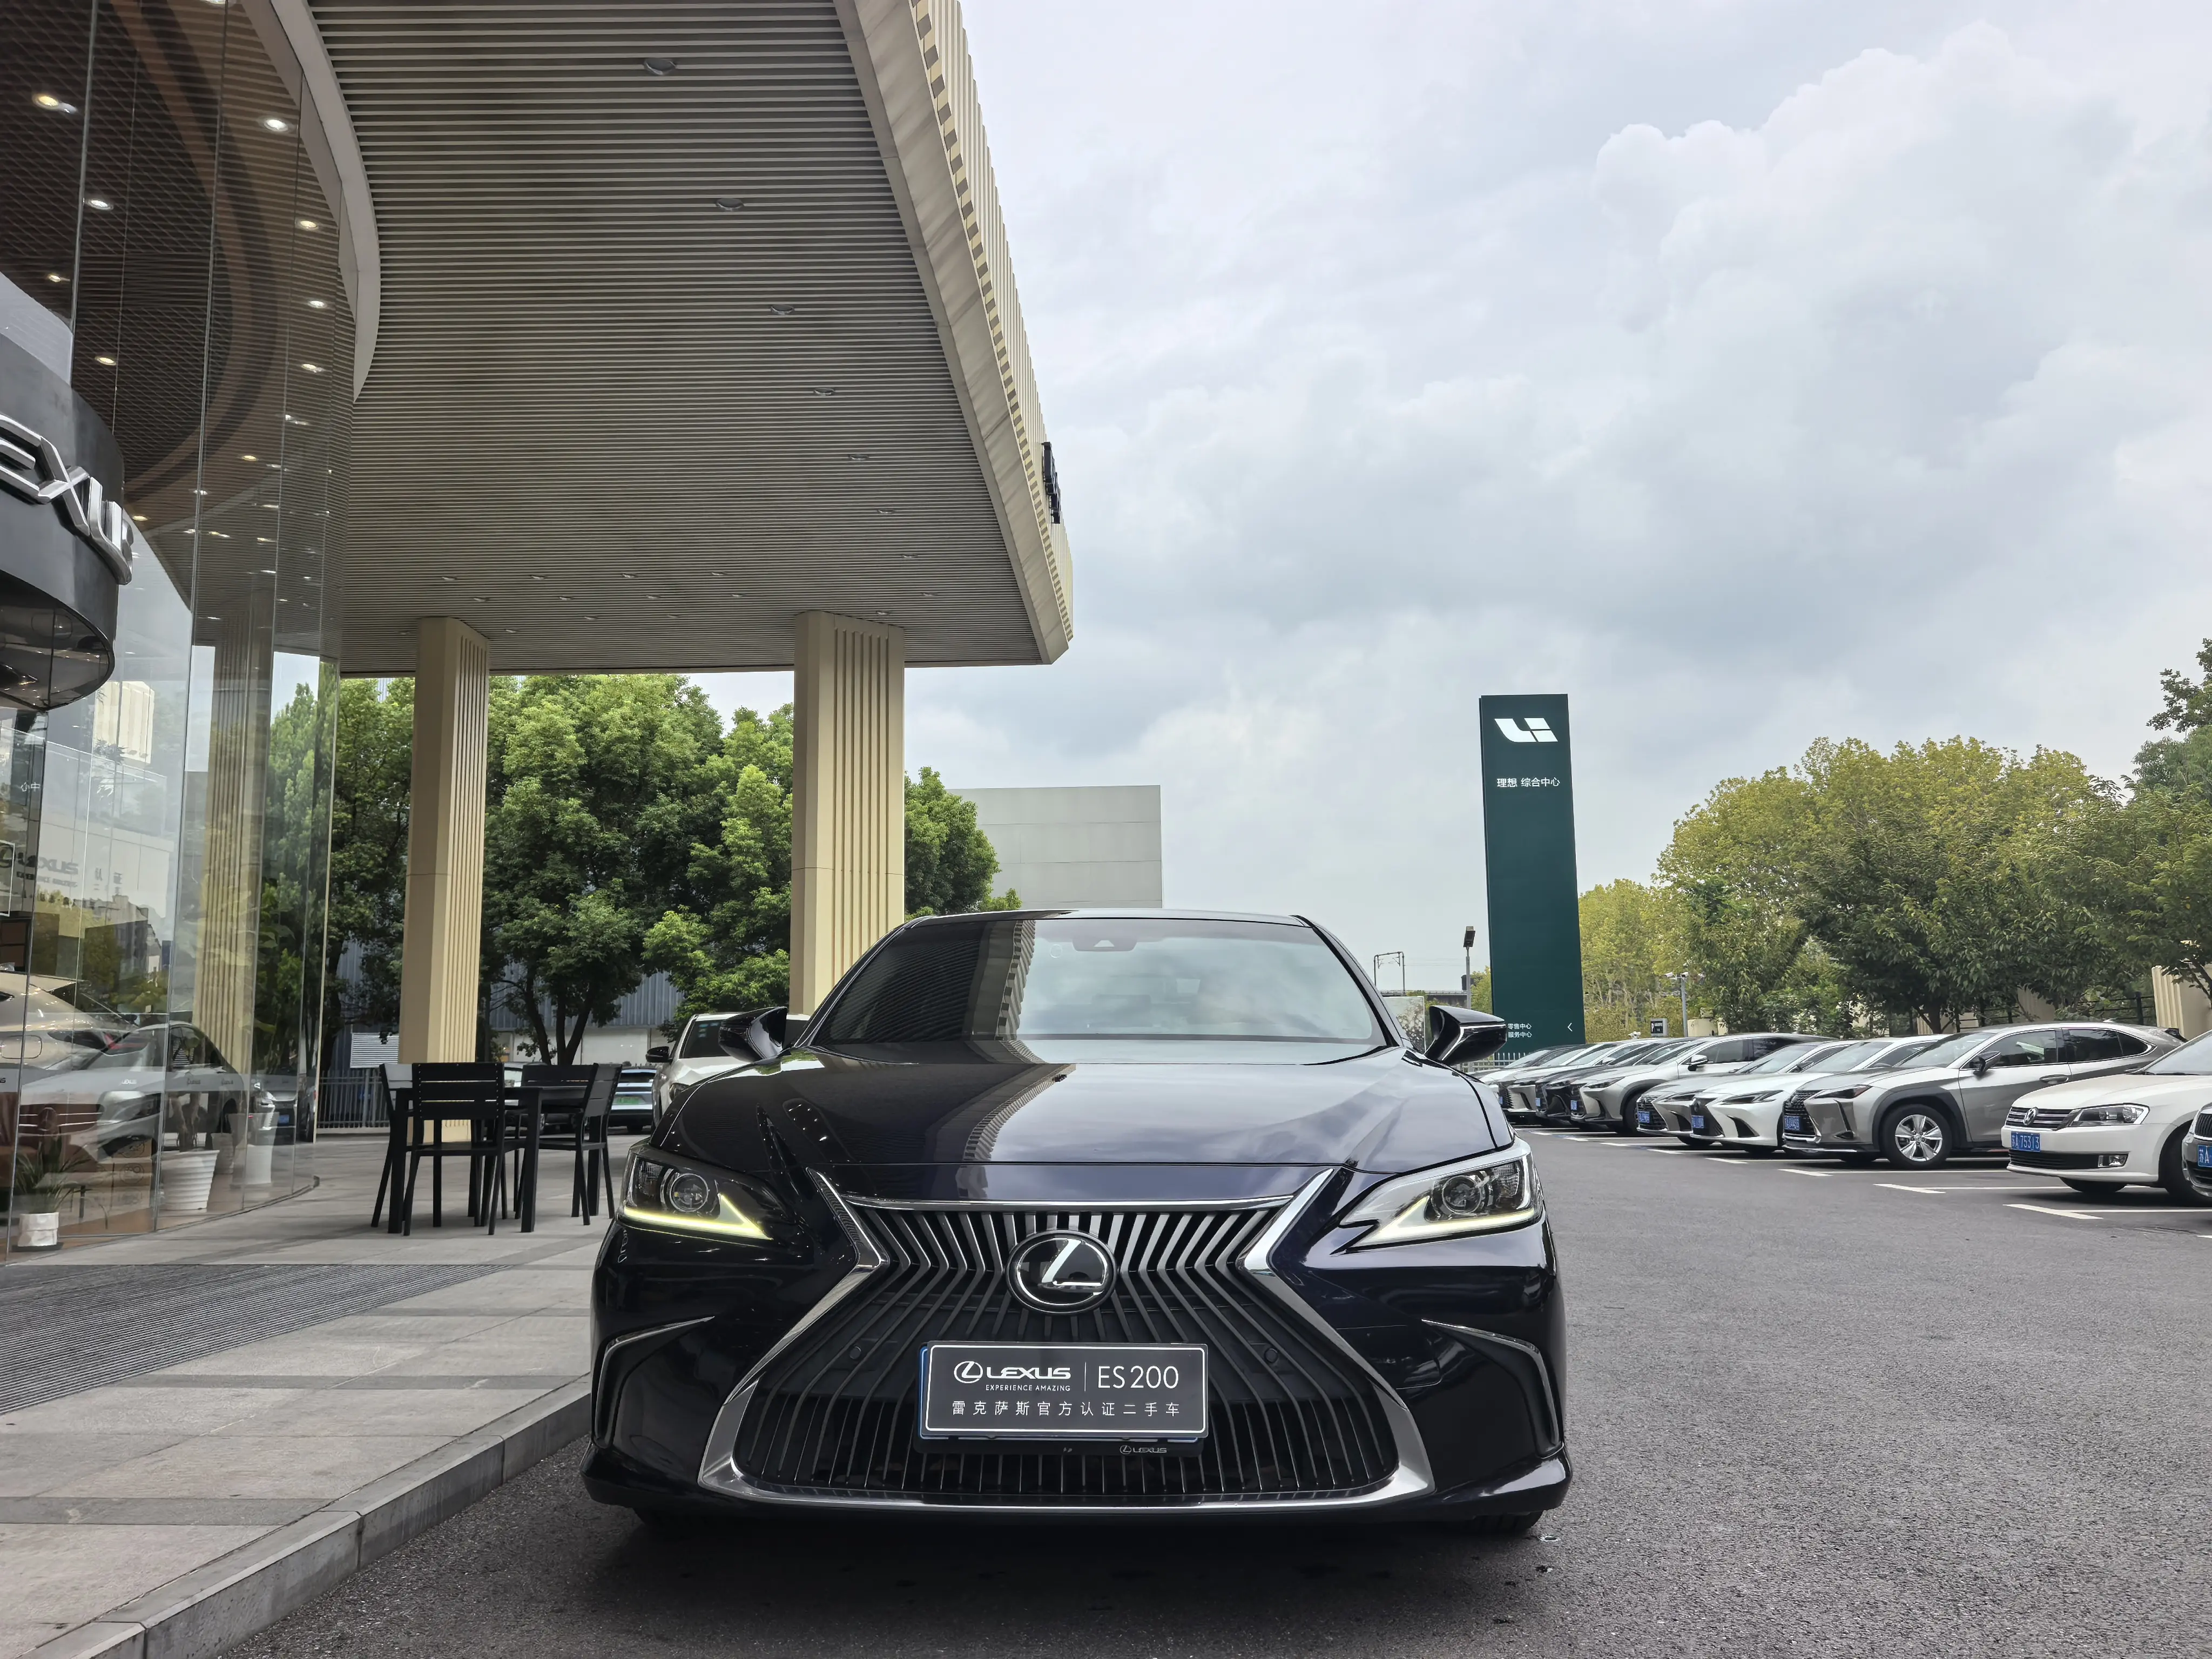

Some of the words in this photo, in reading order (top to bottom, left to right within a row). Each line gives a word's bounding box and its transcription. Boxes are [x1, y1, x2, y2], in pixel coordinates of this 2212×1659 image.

[1496, 778, 1518, 788] 理想
[1520, 777, 1561, 787] 综合中心
[986, 1366, 1071, 1379] LEXUS
[952, 1400, 1179, 1417] 雷克萨斯官方认证二手车
